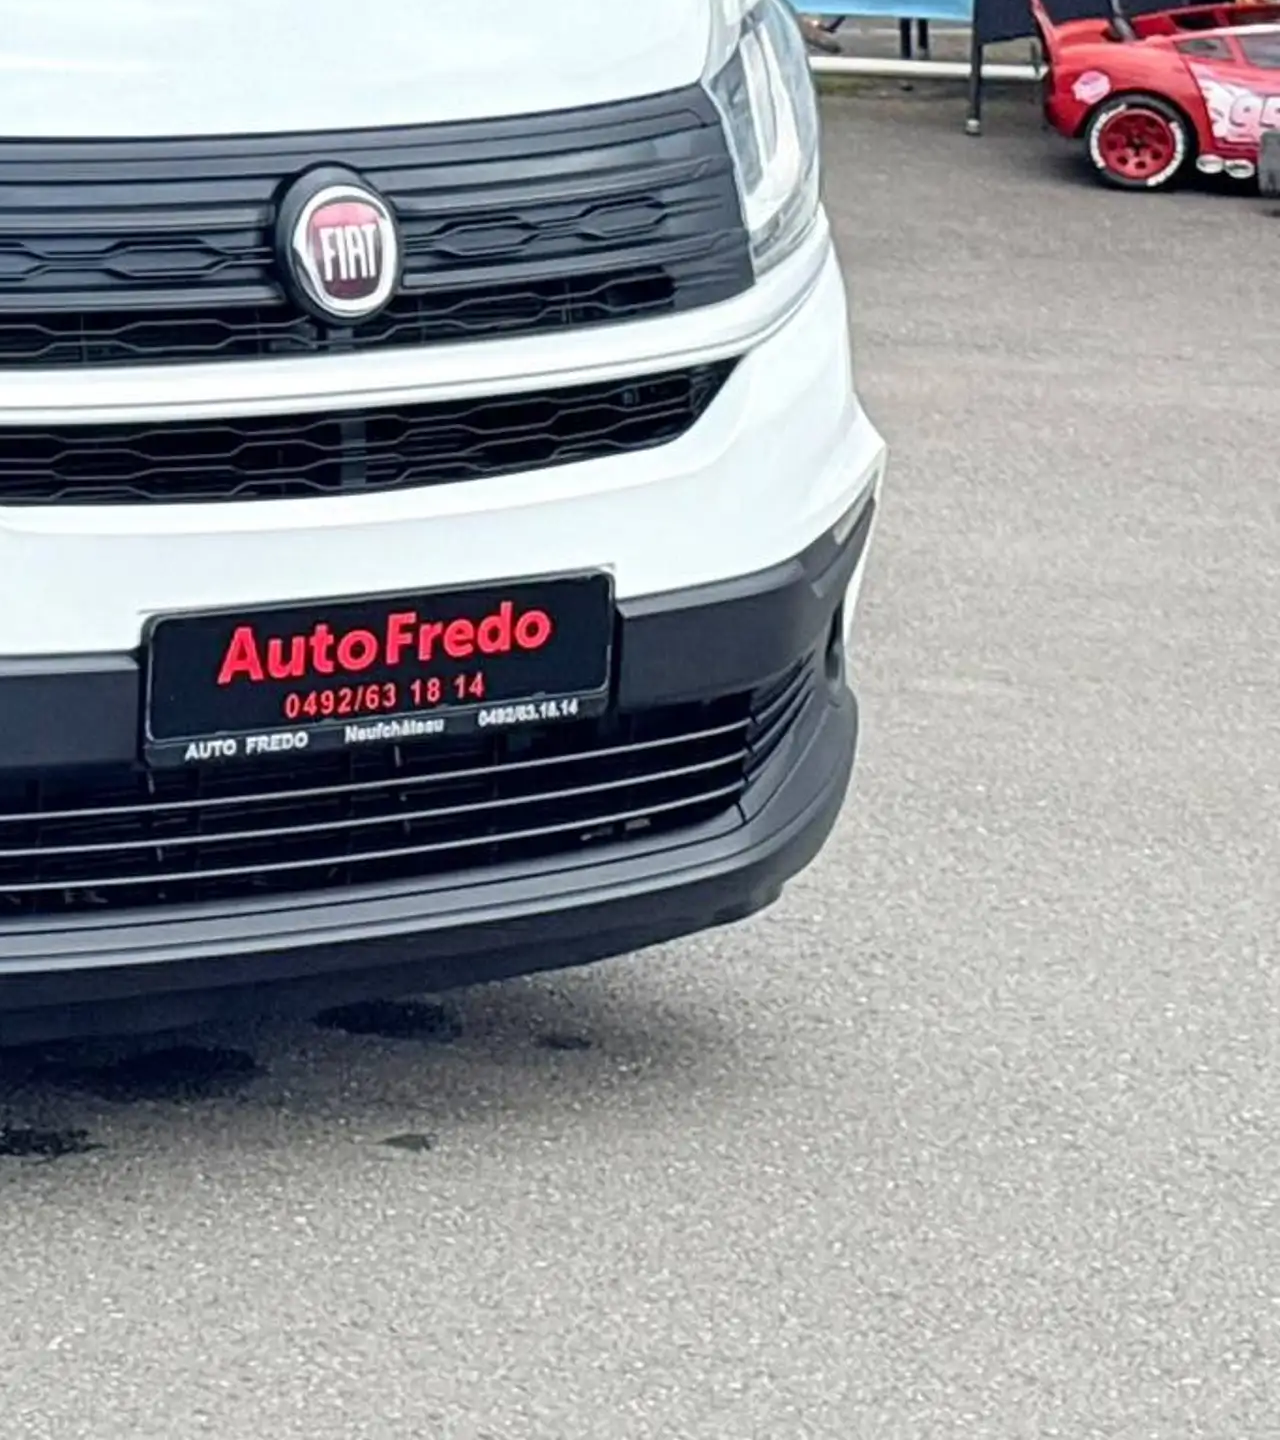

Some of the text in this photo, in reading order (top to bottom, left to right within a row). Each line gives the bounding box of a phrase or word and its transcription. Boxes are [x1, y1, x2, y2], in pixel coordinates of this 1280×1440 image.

[319, 222, 378, 282] FIAT
[284, 671, 487, 719] 0492/63 18 14
[184, 738, 238, 762] AUTO
[245, 731, 310, 756] FREDO
